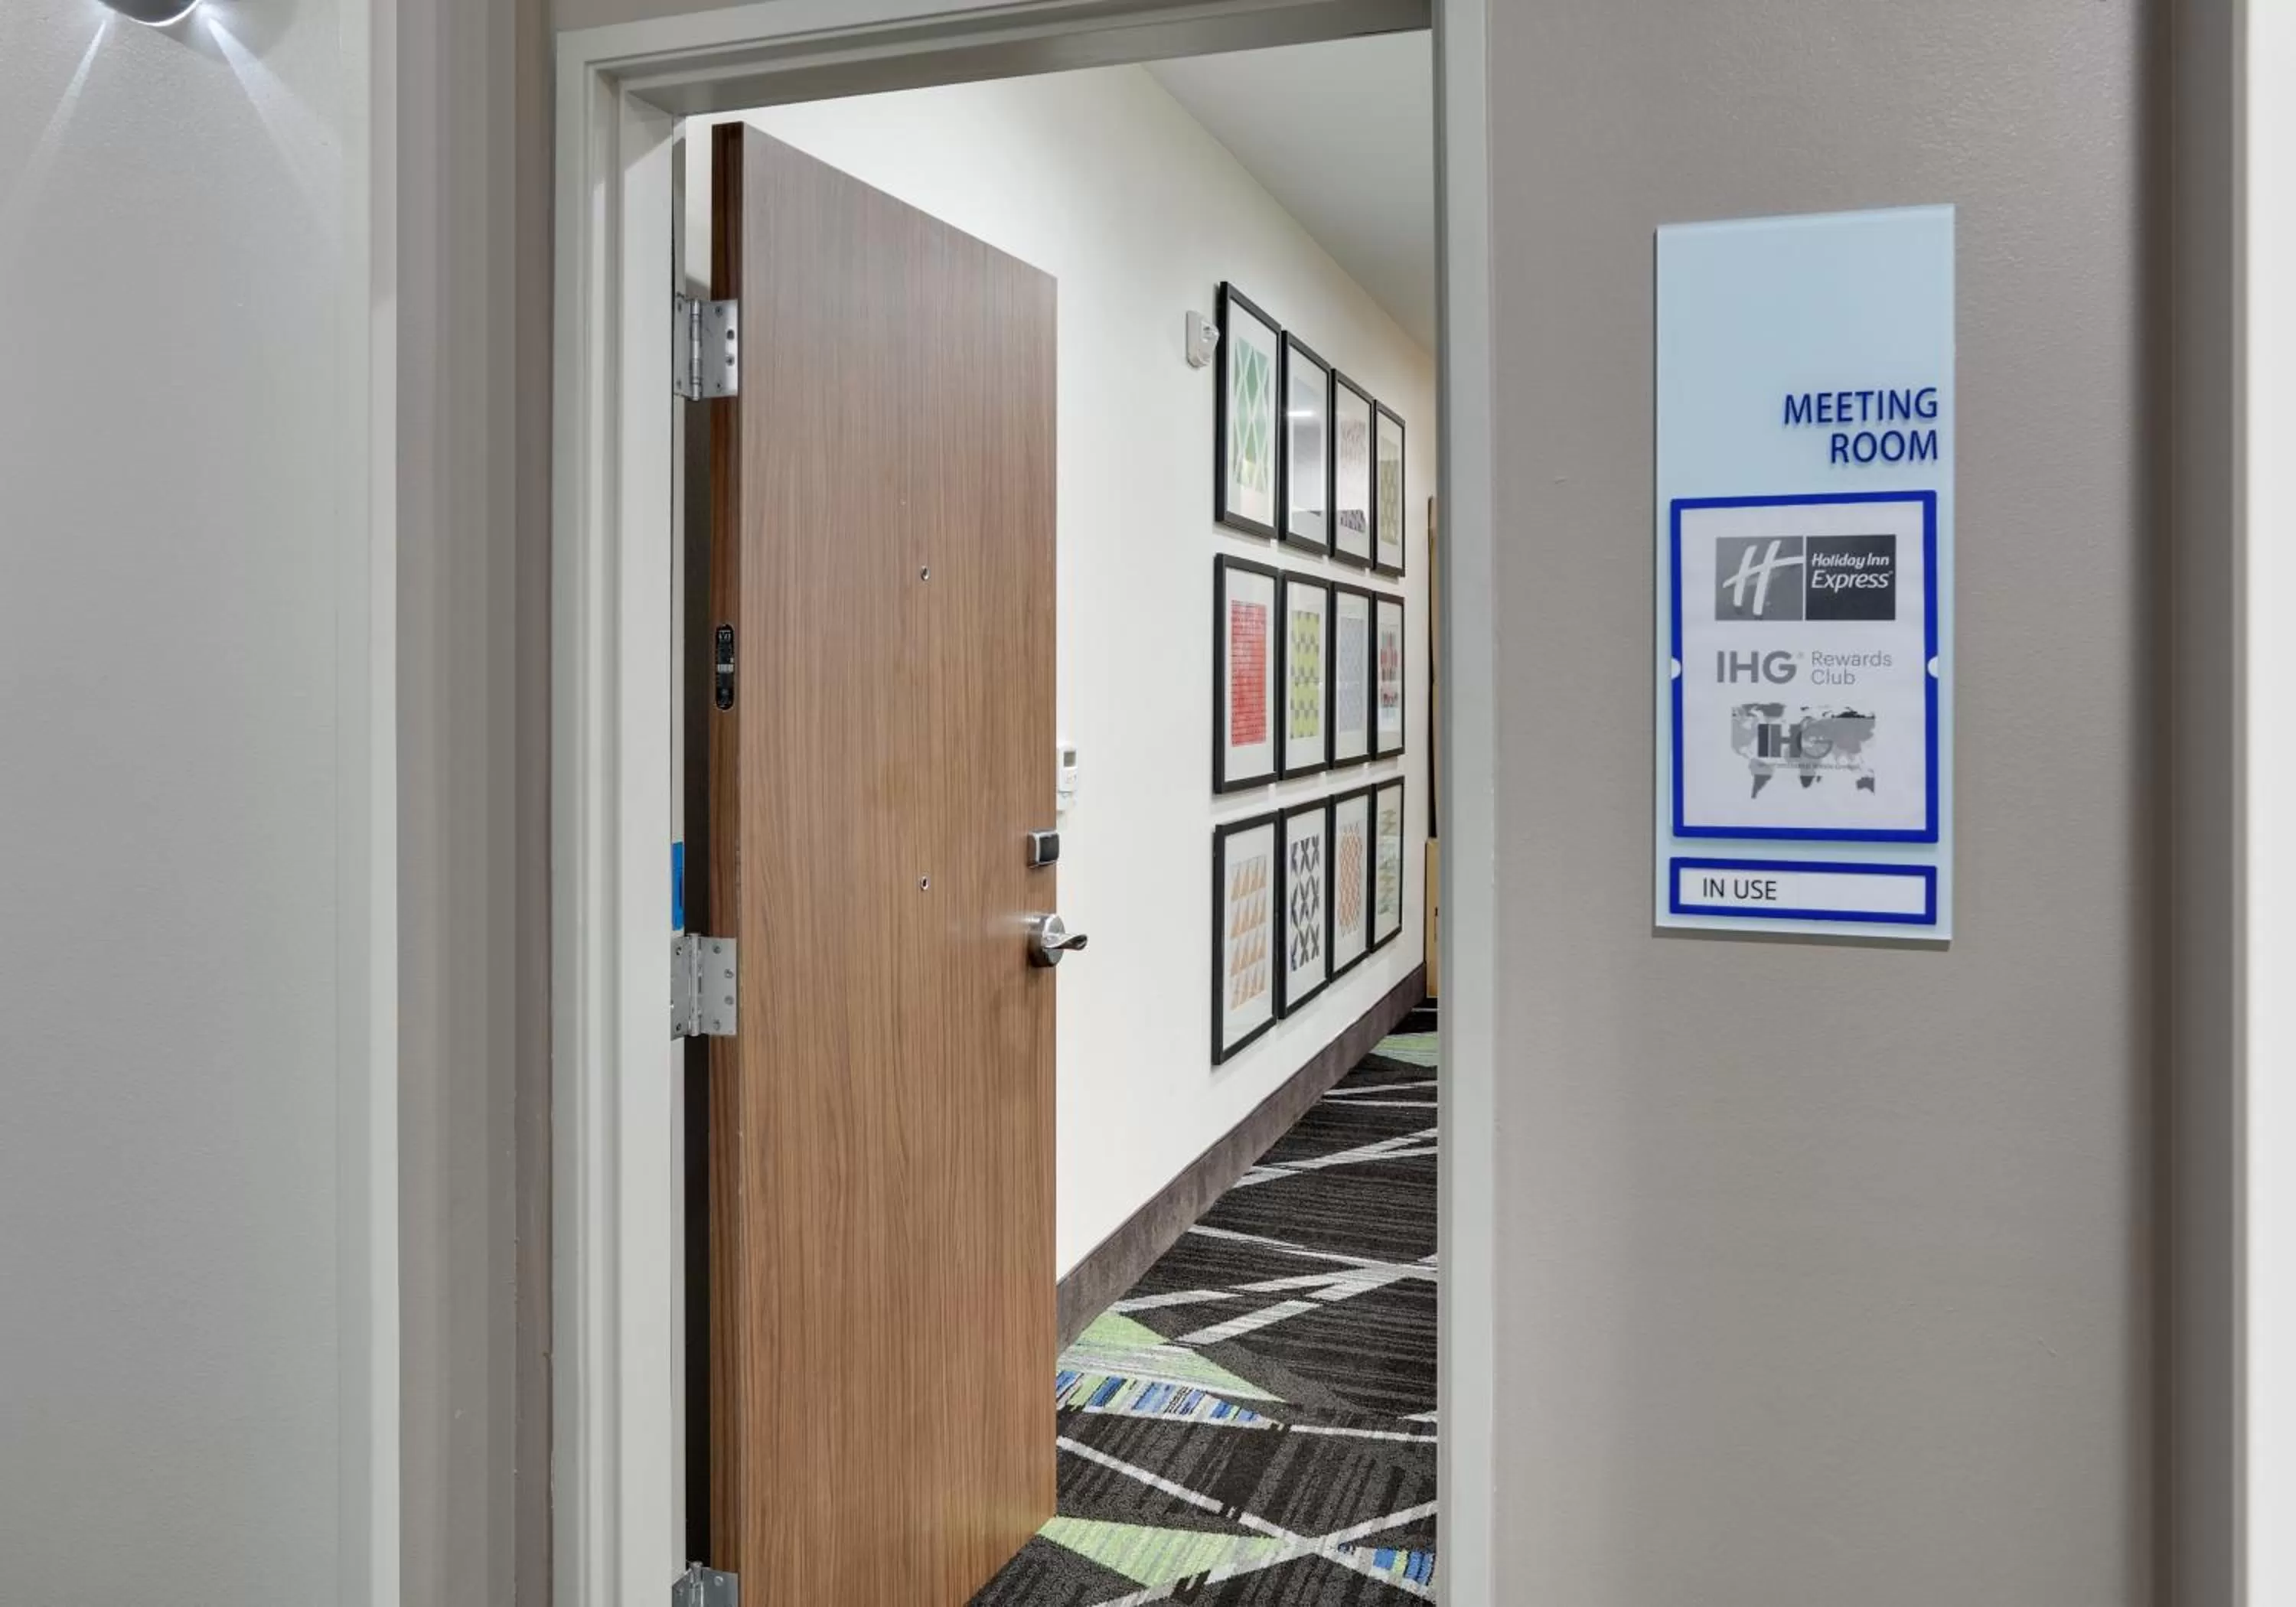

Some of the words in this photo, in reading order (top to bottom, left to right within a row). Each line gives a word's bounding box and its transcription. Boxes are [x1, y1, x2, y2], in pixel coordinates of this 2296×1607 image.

[1784, 387, 1938, 425] MEETING
[1831, 429, 1938, 464] ROOM
[1812, 553, 1866, 569] Holiday
[1867, 553, 1890, 566] Inn
[1811, 569, 1890, 592] Express
[1717, 650, 1797, 684] IHG
[1811, 650, 1893, 667] Rewards
[1811, 669, 1856, 685] Club
[1757, 716, 1834, 760] IHG
[1702, 878, 1725, 898] IN
[1733, 879, 1777, 901] USE
